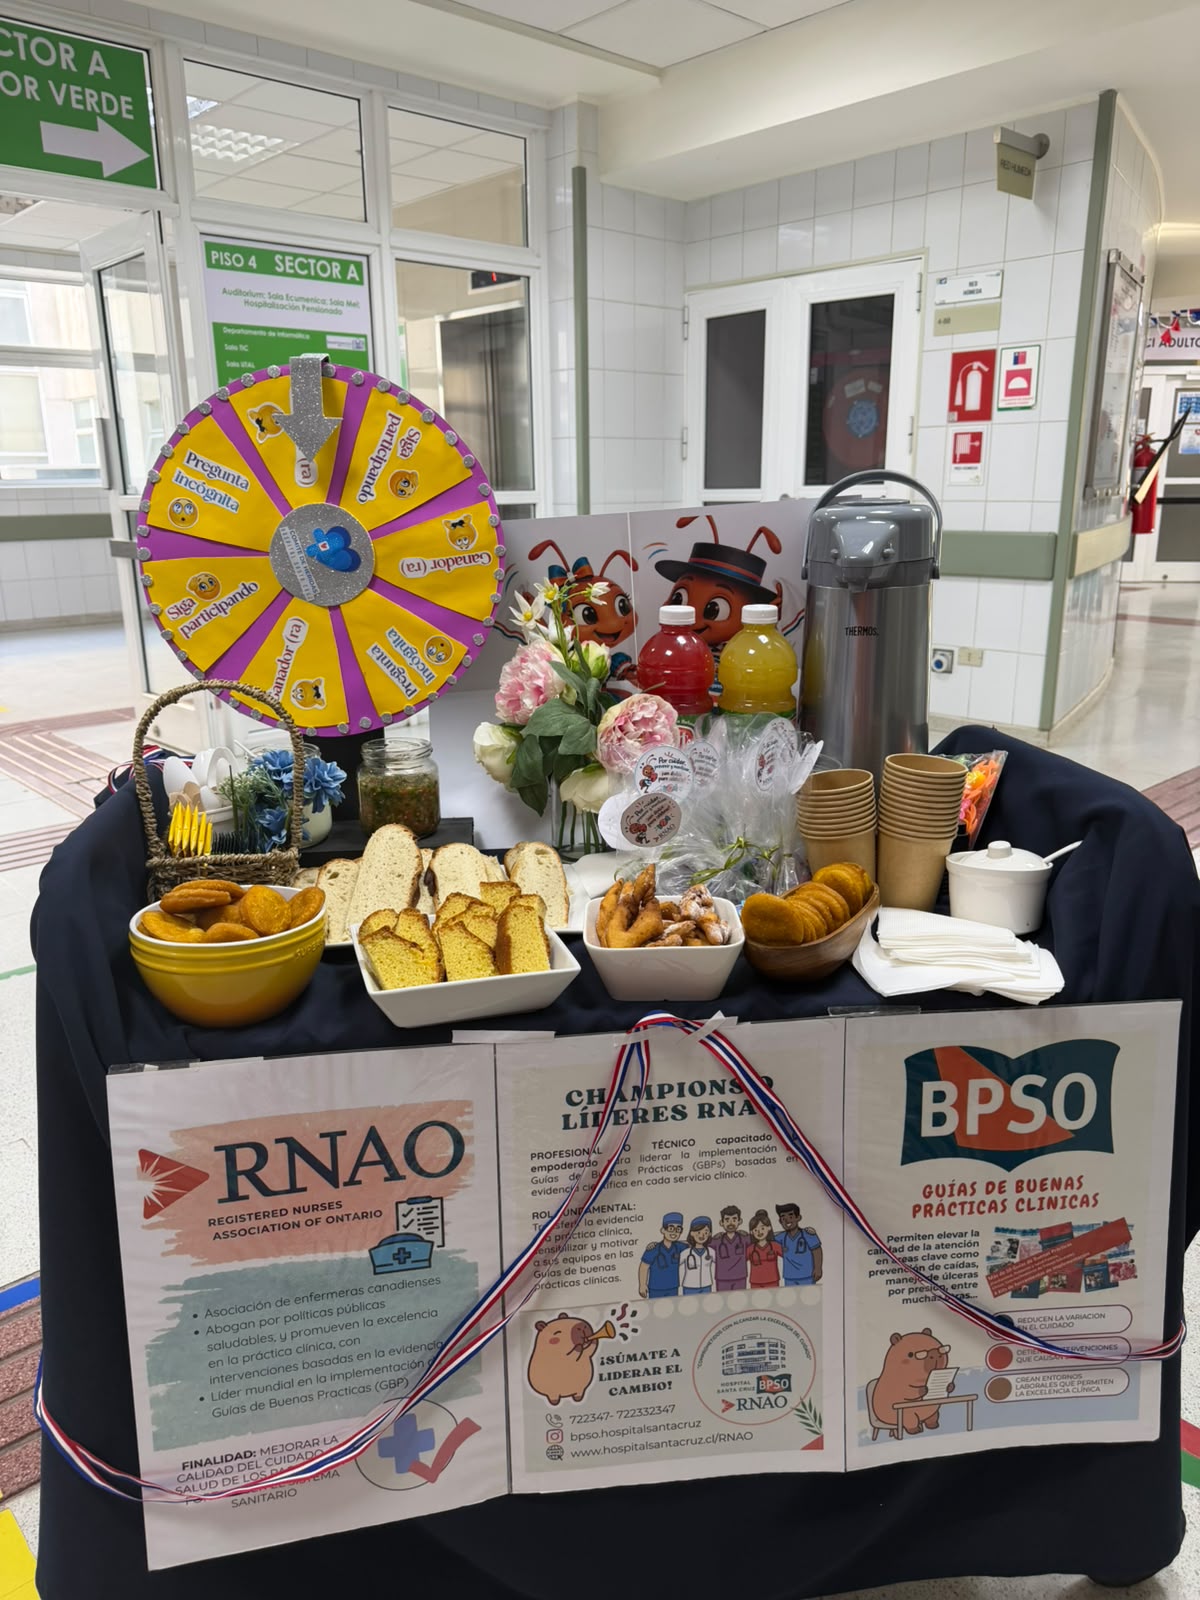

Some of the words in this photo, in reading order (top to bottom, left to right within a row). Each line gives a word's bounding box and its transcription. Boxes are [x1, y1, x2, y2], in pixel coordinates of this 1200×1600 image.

[88, 50, 111, 79] A
[0, 70, 40, 101] OR
[48, 80, 134, 120] VERDE
[211, 251, 244, 267] PISO
[248, 256, 257, 269] 4
[274, 254, 341, 279] SECTOR
[347, 264, 360, 281] A
[267, 292, 284, 300] Sala
[329, 298, 345, 307] Sala
[301, 305, 343, 315] Pensionado
[400, 428, 421, 458] Siga
[359, 412, 402, 503] participando
[185, 451, 250, 490] Pregunta
[400, 557, 427, 576] (ra)
[431, 552, 492, 572] Ganador
[167, 598, 197, 620] Siga
[179, 582, 259, 639] participando
[272, 647, 294, 700] anador
[285, 618, 306, 644] (ra)
[371, 644, 419, 698] Pregunta
[697, 1100, 758, 1119] RNA
[921, 1072, 1097, 1137] BPSO
[530, 1147, 602, 1161] PROFESIONAL
[652, 1138, 696, 1150] TÉCNICO
[715, 1133, 773, 1145] capacitado
[214, 1120, 465, 1204] RNAO
[530, 1160, 598, 1173] empoderado
[640, 1153, 672, 1163] liderar
[698, 1145, 777, 1158] implementación
[530, 1175, 559, 1185] Guías
[637, 1163, 683, 1175] Prácticas
[692, 1160, 726, 1171] (GBPs)
[735, 1156, 777, 1167] basadas
[645, 1175, 670, 1186] cada
[673, 1172, 711, 1184] servicio
[714, 1171, 747, 1180] clínico.
[922, 1179, 977, 1199] GUÍAS
[985, 1180, 1007, 1195] DE
[1015, 1175, 1083, 1193] BUENAS
[208, 1208, 289, 1227] REGISTERED
[293, 1200, 343, 1214] NURSES
[532, 1211, 553, 1220] ROL
[912, 1198, 1008, 1218] PRÁCTICAS
[1015, 1192, 1099, 1213] CLINICAS
[212, 1221, 301, 1240] ASSOCIATION
[304, 1217, 322, 1228] OF
[326, 1209, 383, 1224] ONTARIO
[596, 1215, 644, 1226] evidencia
[599, 1227, 632, 1237] clínica,
[887, 1232, 934, 1243] Permiten
[937, 1230, 968, 1239] elevar
[600, 1239, 639, 1249] motivar
[934, 1240, 979, 1250] atención
[562, 1254, 601, 1264] equipos
[619, 1250, 634, 1258] las
[921, 1252, 948, 1261] clave
[950, 1251, 979, 1259] como
[943, 1260, 979, 1270] caídas,
[534, 1268, 561, 1279] Guías
[564, 1267, 577, 1276] de
[580, 1263, 616, 1274] buenas
[942, 1270, 978, 1281] úlceras
[535, 1278, 580, 1290] prácticas
[583, 1275, 621, 1285] clínicas.
[888, 1288, 905, 1297] por
[951, 1281, 978, 1290] entre
[205, 1301, 271, 1319] Asociación
[275, 1297, 290, 1307] de
[294, 1287, 364, 1304] enfermeras
[367, 1277, 441, 1294] canadienses
[206, 1320, 255, 1336] Abogan
[259, 1317, 280, 1328] por
[284, 1308, 333, 1325] políticas
[337, 1301, 386, 1317] públicas
[1017, 1315, 1053, 1324] REDUCEN
[1039, 1321, 1074, 1330] CUIDADO
[207, 1334, 277, 1352] saludables,
[291, 1321, 359, 1340] promueven
[377, 1309, 438, 1326] excelencia
[242, 1347, 292, 1365] práctica
[296, 1340, 336, 1354] clínica,
[338, 1336, 361, 1348] con
[600, 1349, 667, 1366] ¡SÚMATE
[671, 1348, 680, 1357] A
[209, 1363, 298, 1385] intervenciones
[302, 1354, 353, 1370] basadas
[389, 1340, 443, 1357] evidencia
[598, 1366, 662, 1382] LIDERAR
[665, 1364, 683, 1374] EL
[211, 1388, 242, 1402] Líder
[245, 1378, 294, 1396] mundial
[297, 1378, 312, 1388] en
[330, 1359, 425, 1384] implementación
[759, 1378, 789, 1390] BPSO
[1015, 1382, 1058, 1390] LABORALES
[1077, 1378, 1114, 1386] PERMITEN
[1042, 1373, 1082, 1381] ENTORNOS
[212, 1404, 246, 1418] Guías
[249, 1401, 265, 1411] de
[269, 1393, 314, 1409] Buenas
[317, 1383, 372, 1400] Practicas
[374, 1377, 409, 1393] (GBP)
[608, 1381, 673, 1396] CAMBIO!
[1025, 1387, 1070, 1396] EXCELENCIA
[736, 1395, 788, 1411] RNAO
[569, 1412, 614, 1424] 722347-
[616, 1404, 676, 1419] 722332347
[570, 1419, 702, 1442] bpso.hospitalsantacruz
[182, 1450, 256, 1471] FINALIDAD:
[260, 1440, 320, 1457] MEJORAR
[323, 1435, 338, 1446] LA
[571, 1431, 753, 1458] www.hospitalsantacruz.cl/RNAO
[177, 1465, 234, 1483] CALIDAD
[237, 1461, 258, 1474] DEL
[264, 1449, 325, 1466] CUIDADO
[175, 1480, 218, 1496] SALUD
[222, 1476, 239, 1487] DE
[243, 1471, 268, 1482] LOS
[231, 1488, 298, 1508] SANITARIO
